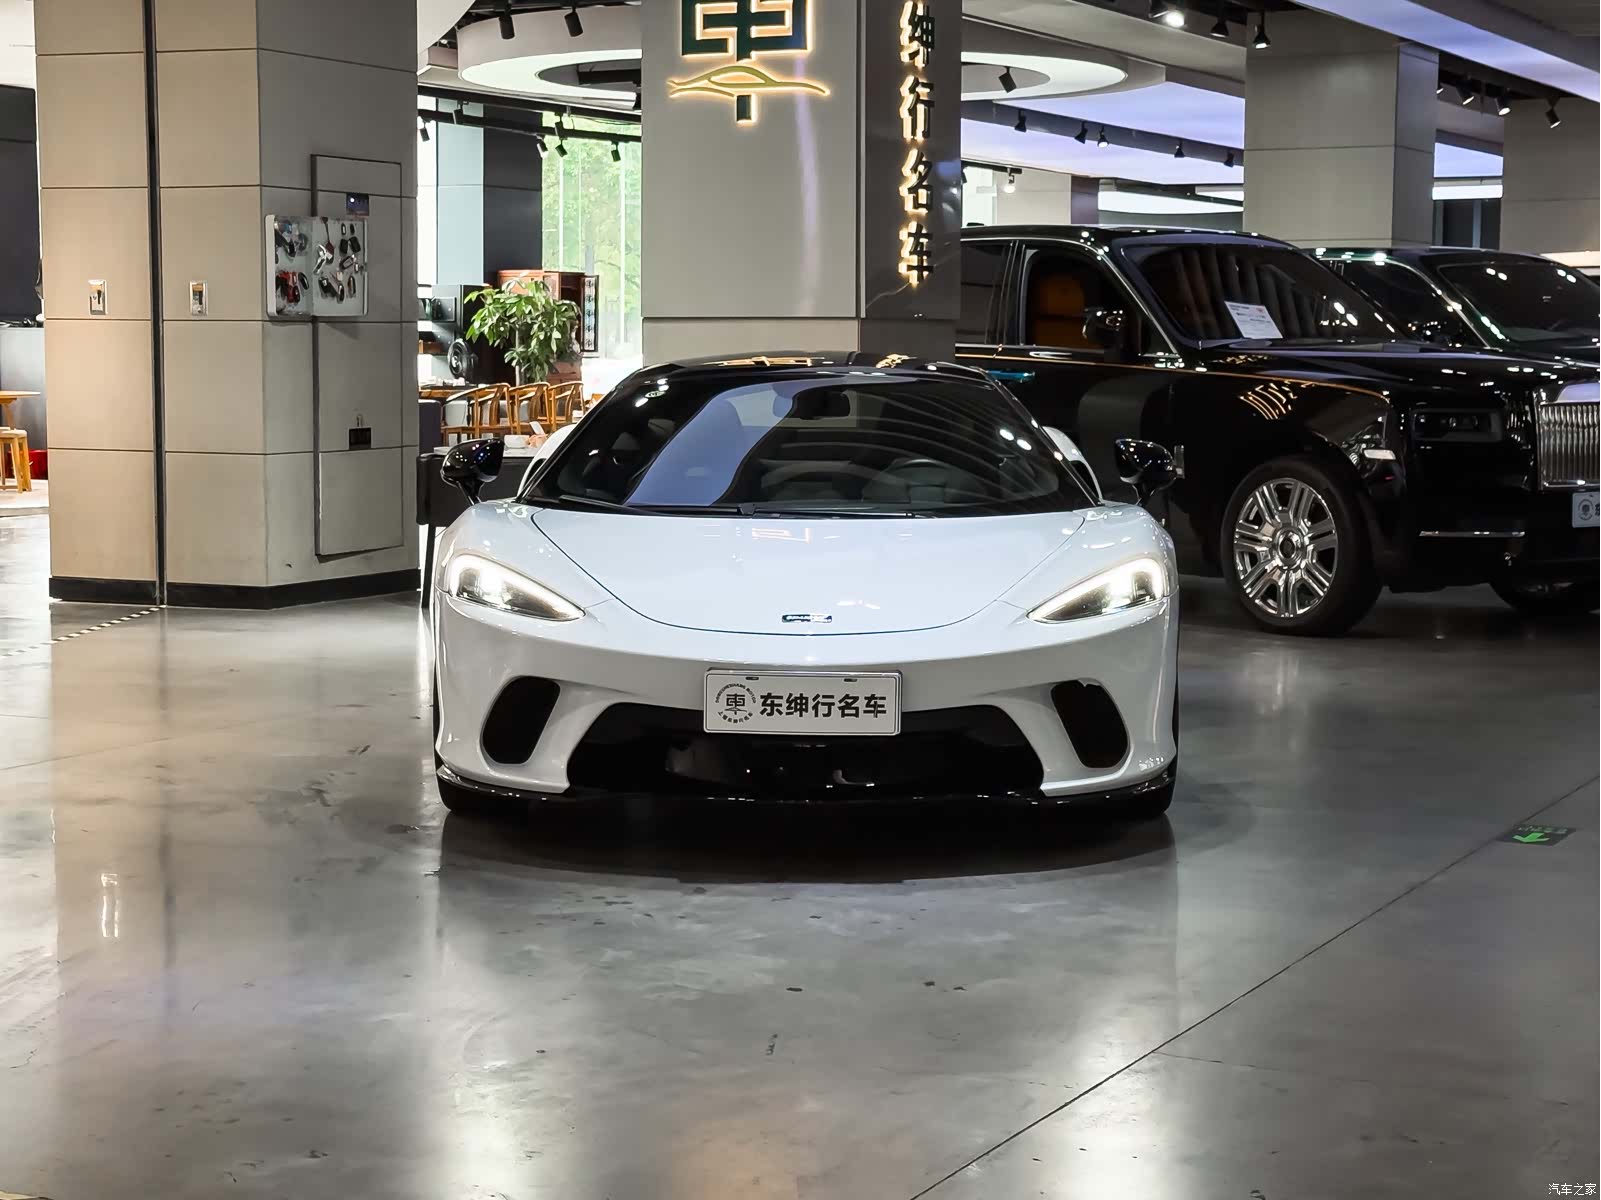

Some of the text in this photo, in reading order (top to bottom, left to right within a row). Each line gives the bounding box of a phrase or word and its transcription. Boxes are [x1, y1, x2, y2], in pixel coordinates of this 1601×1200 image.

[759, 692, 887, 718] 东绅行名车
